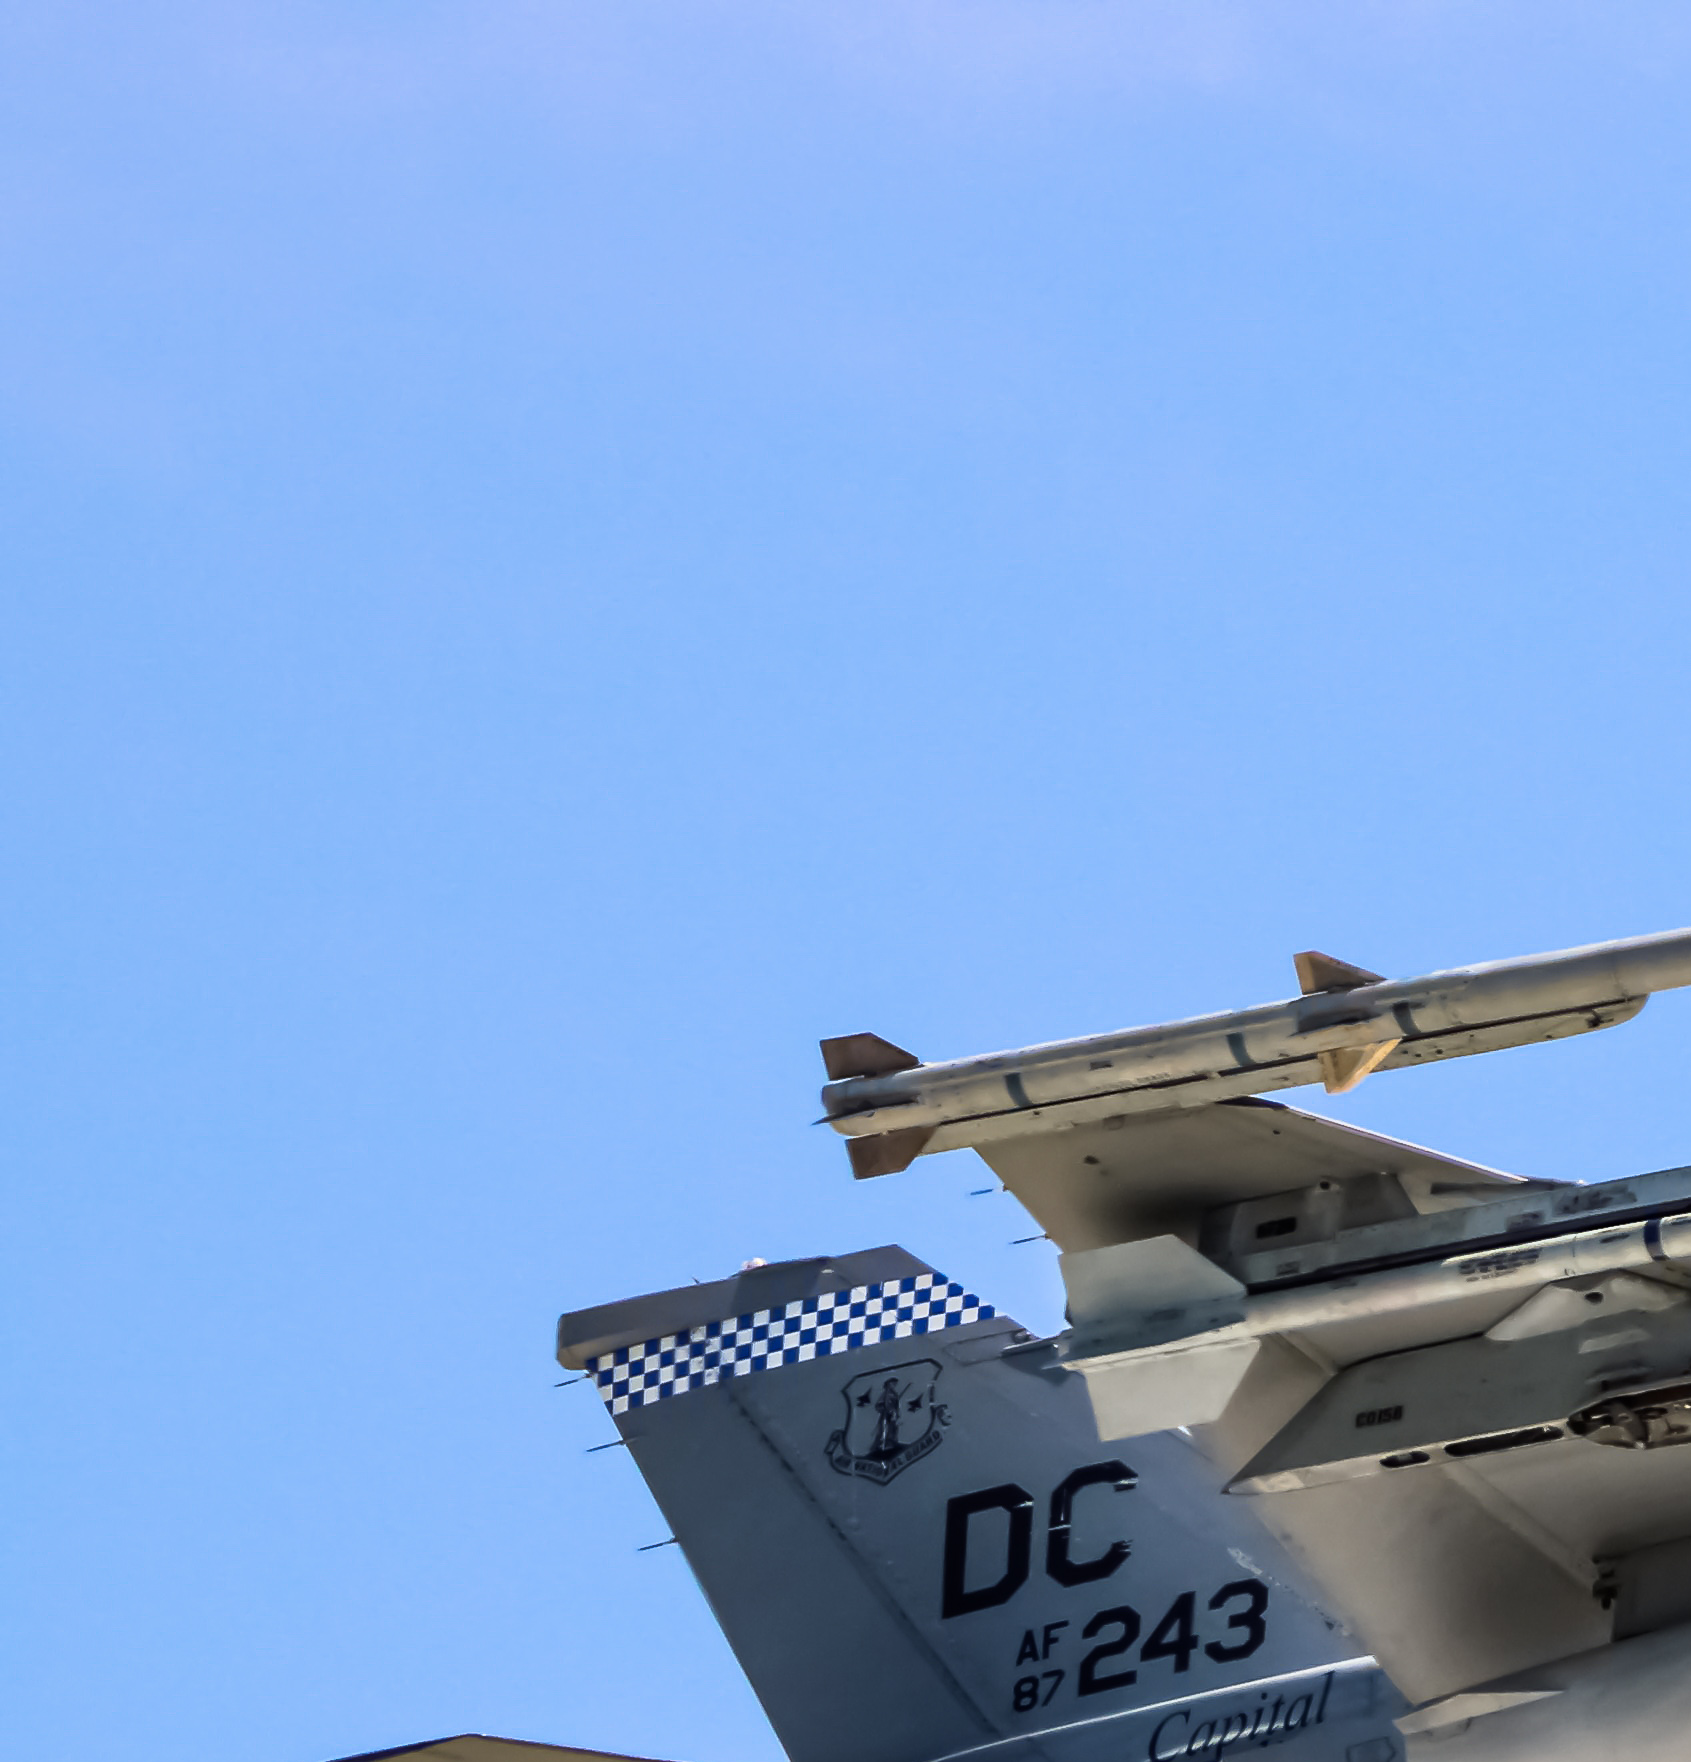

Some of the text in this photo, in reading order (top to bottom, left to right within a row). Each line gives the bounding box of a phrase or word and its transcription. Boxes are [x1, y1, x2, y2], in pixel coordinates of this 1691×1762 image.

[941, 1459, 1139, 1620] DC
[1016, 1620, 1070, 1667] AF
[1077, 1578, 1269, 1697] 243
[1013, 1669, 1066, 1714] 87
